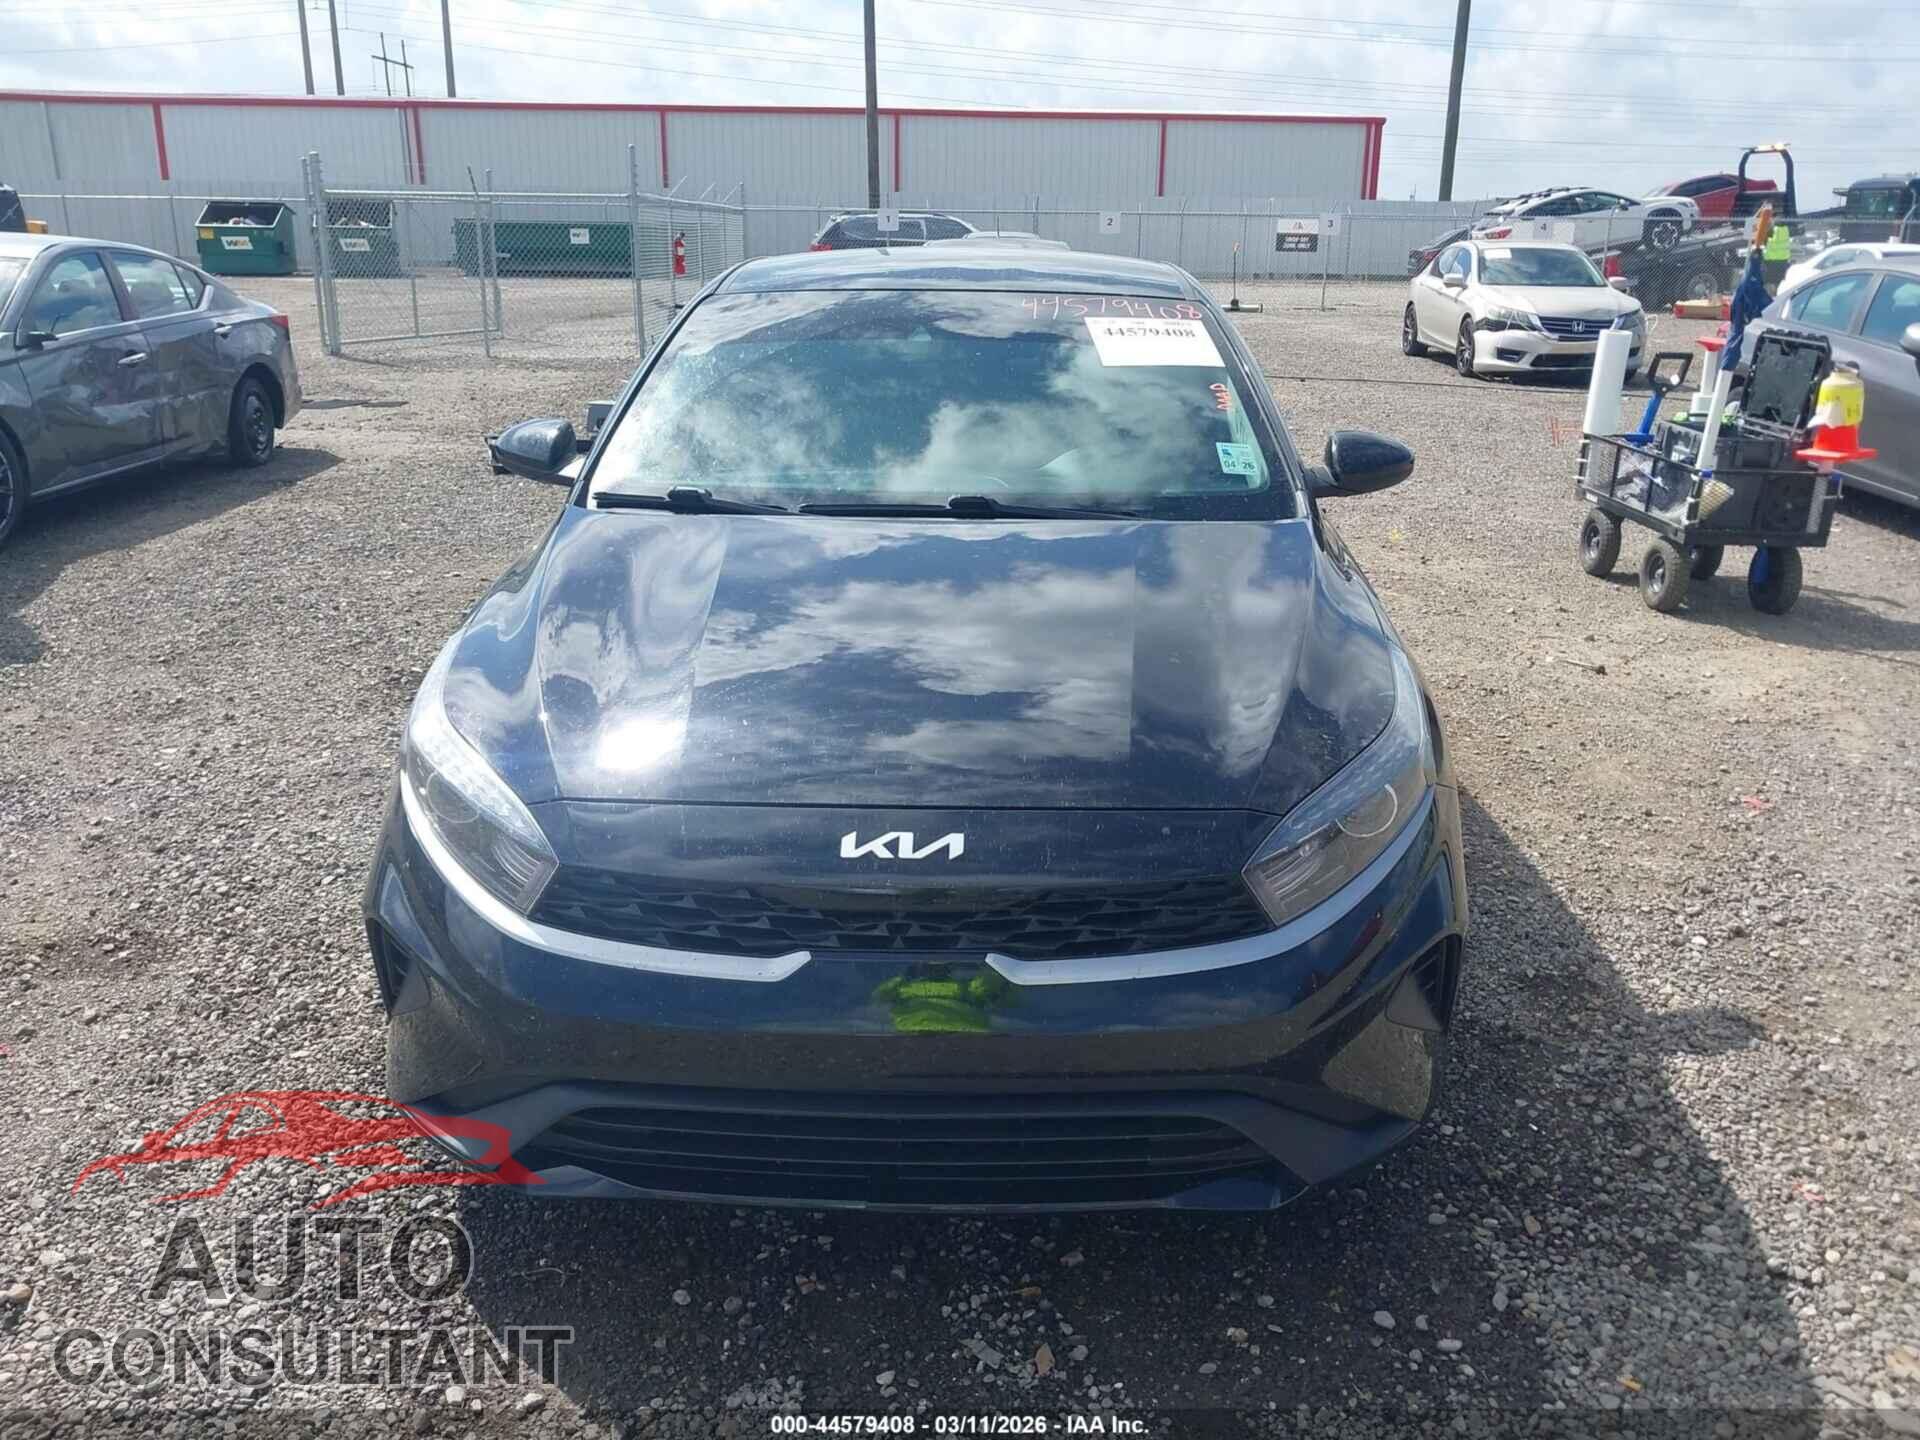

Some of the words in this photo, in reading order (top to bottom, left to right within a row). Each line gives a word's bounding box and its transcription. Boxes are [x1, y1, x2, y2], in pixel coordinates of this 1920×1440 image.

[1106, 217, 1113, 226] 2
[1327, 219, 1334, 228] 3
[1022, 296, 1202, 320] 44579408
[1103, 327, 1197, 338] 44579408
